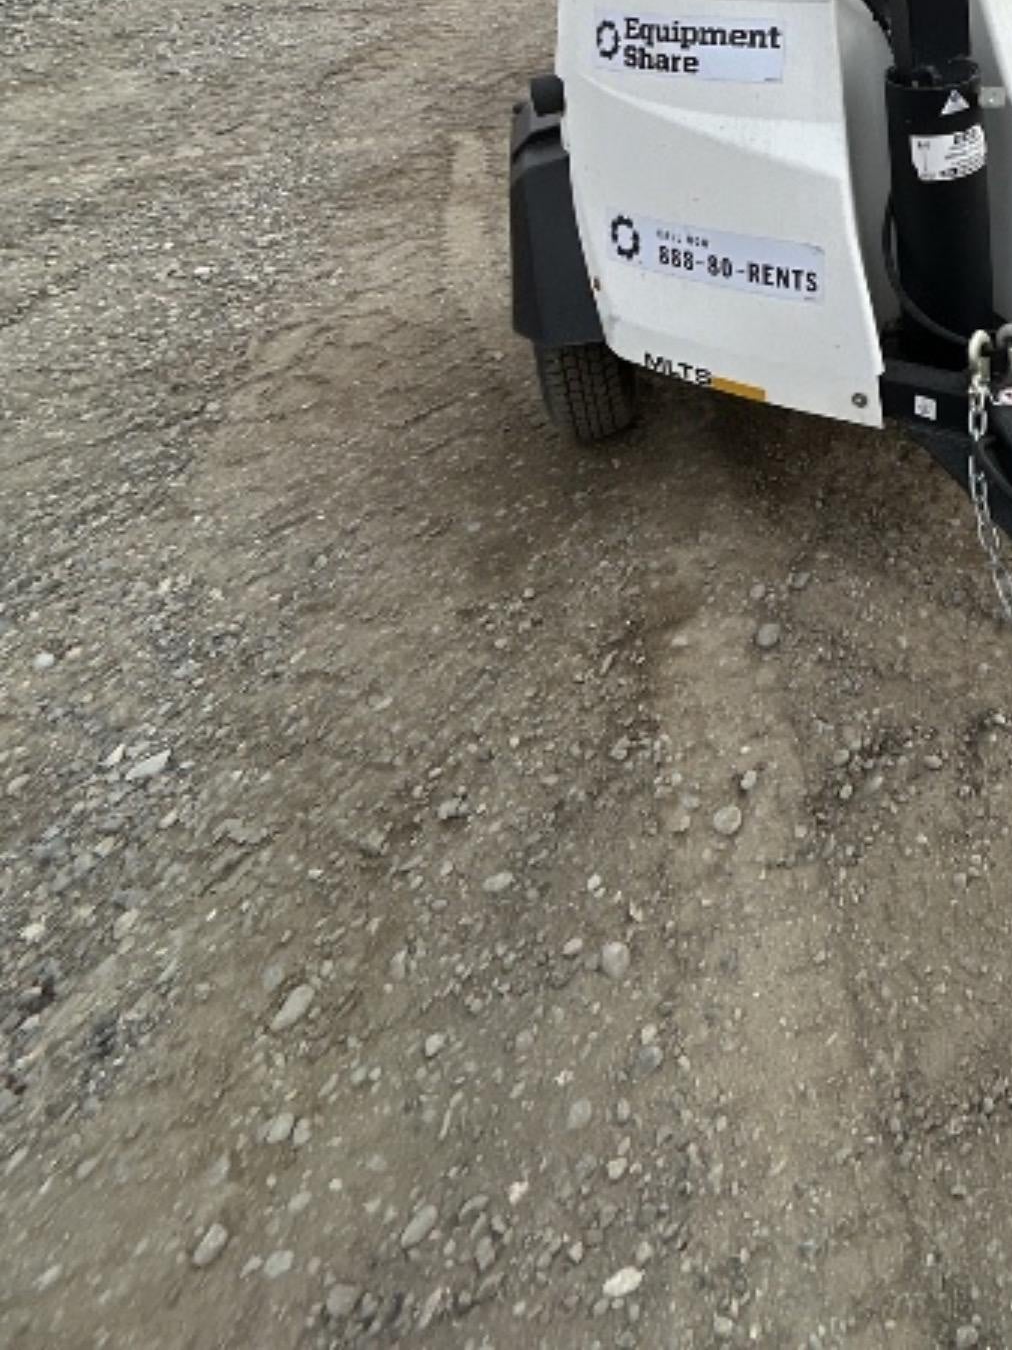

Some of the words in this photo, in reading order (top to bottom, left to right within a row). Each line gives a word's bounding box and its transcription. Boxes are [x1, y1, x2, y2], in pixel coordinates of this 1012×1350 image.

[624, 16, 782, 50] Equipment
[623, 44, 699, 73] Share
[658, 245, 818, 292] 888-80-RENTS
